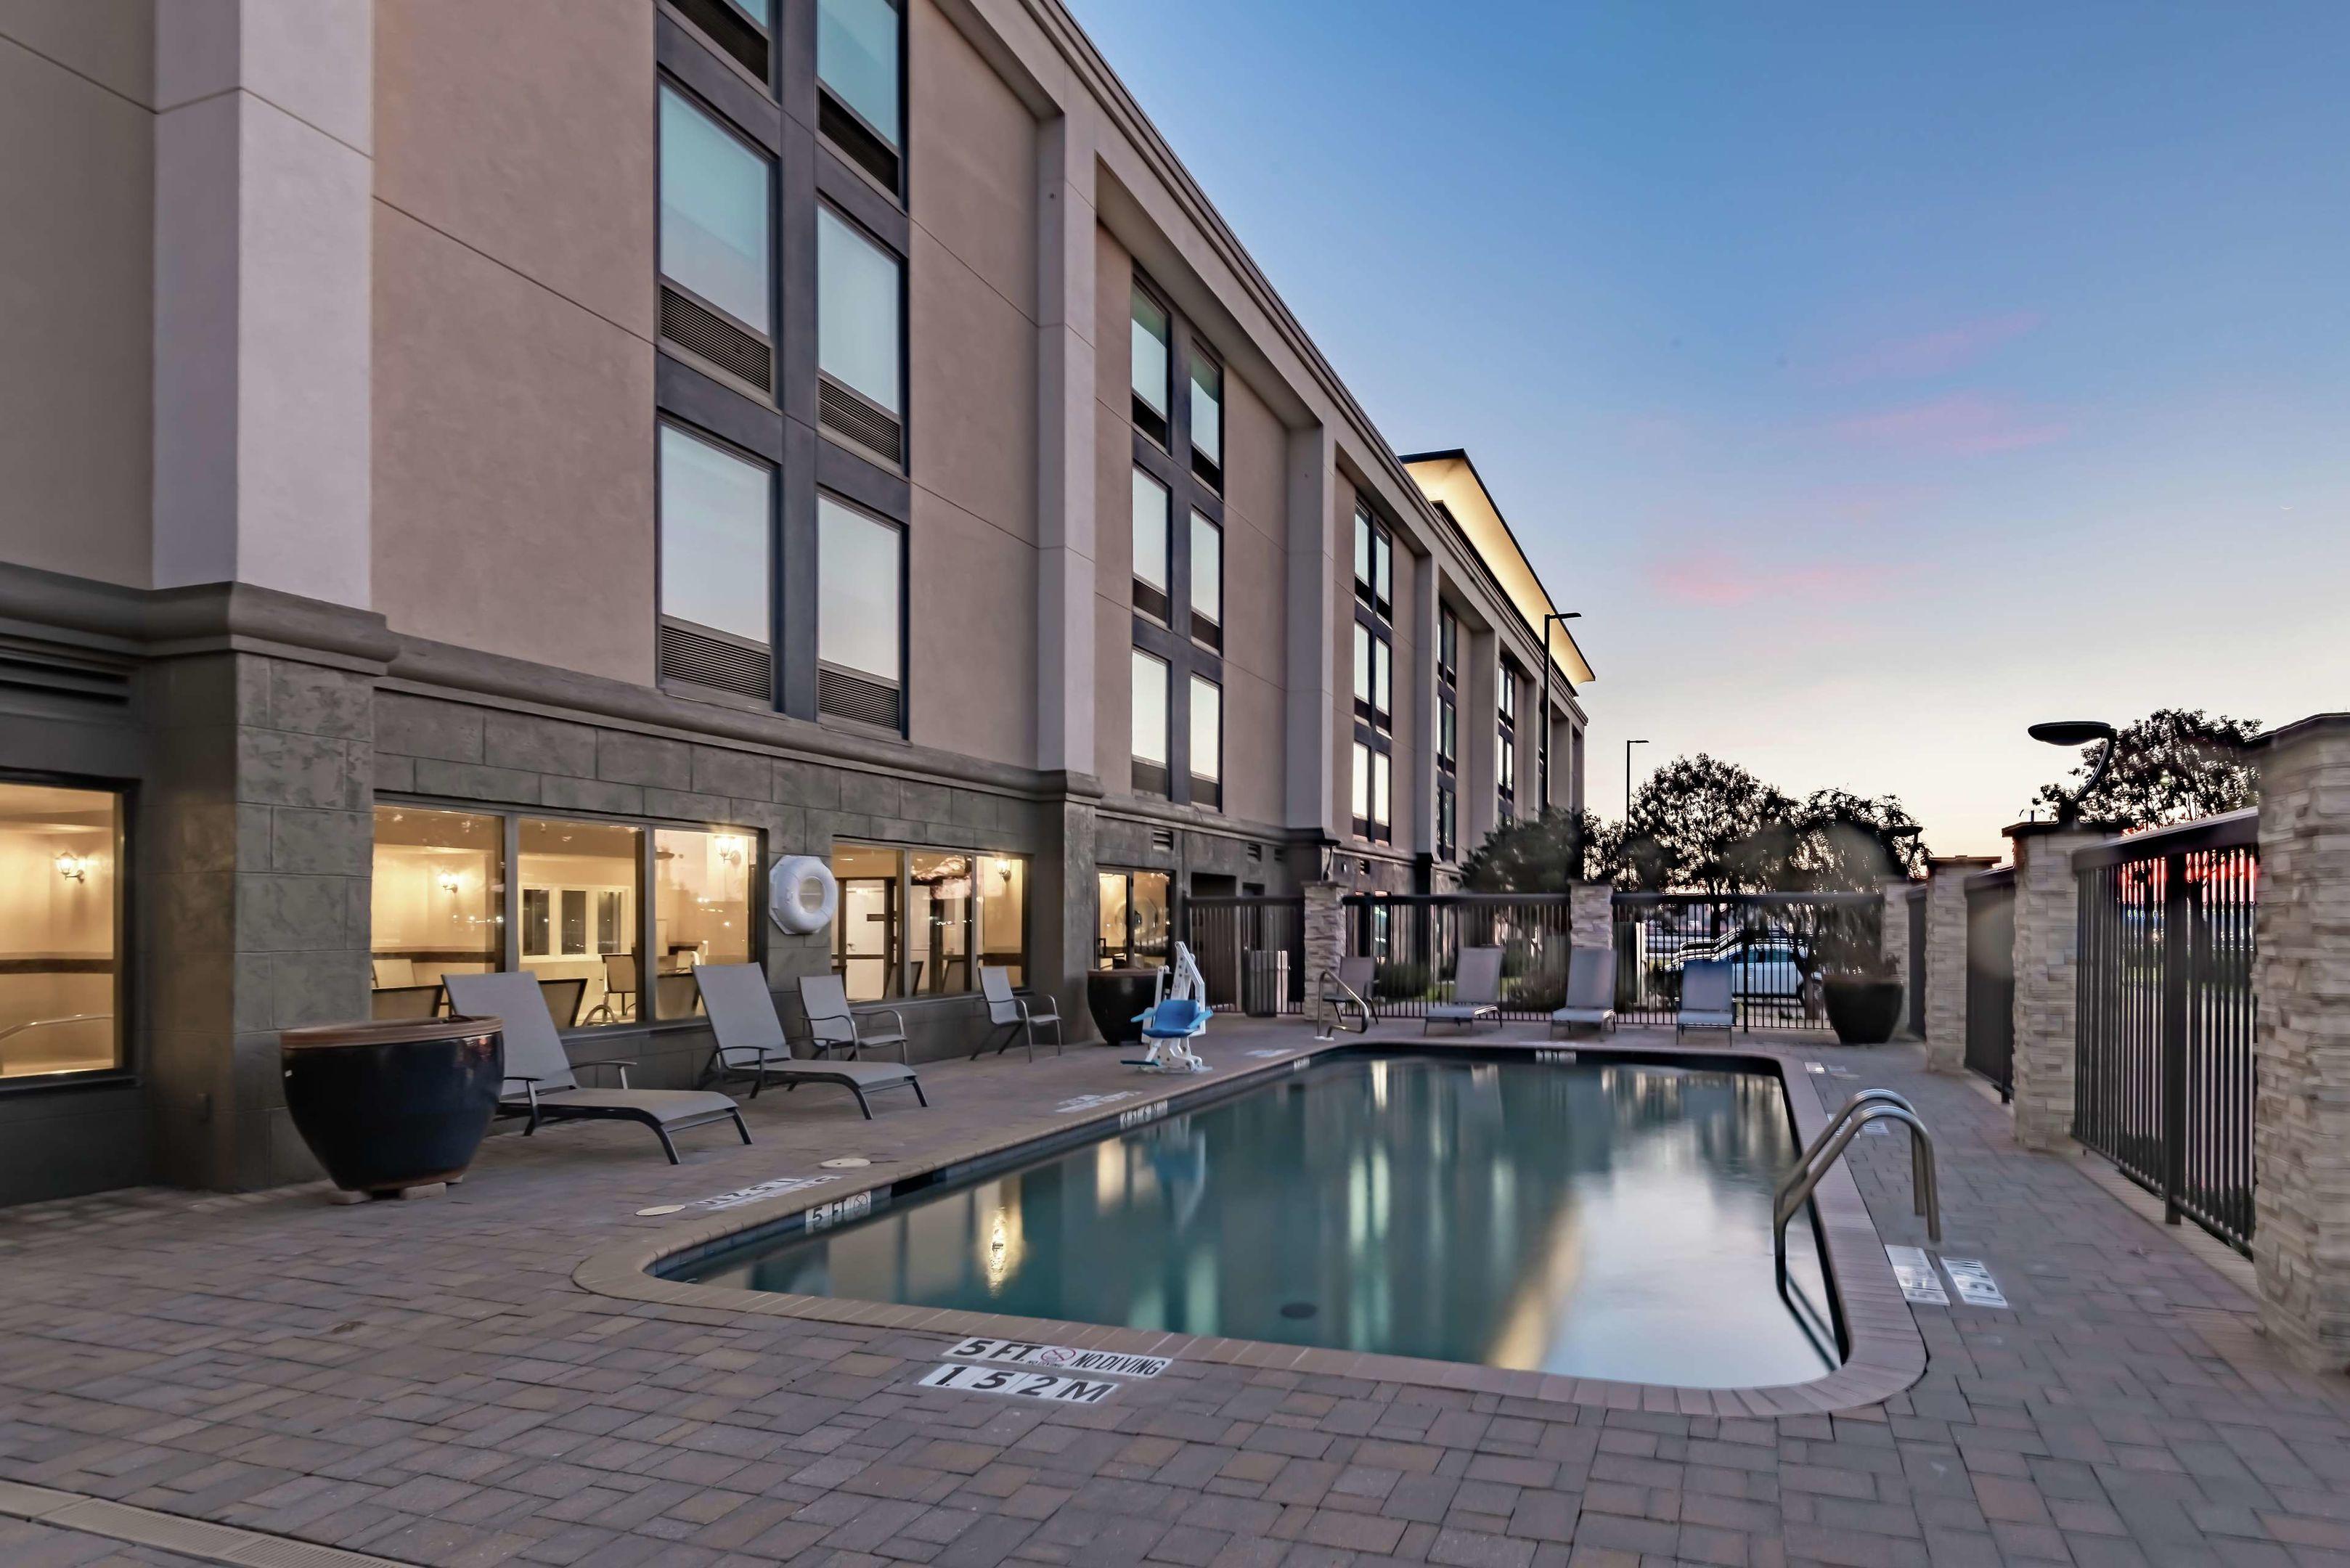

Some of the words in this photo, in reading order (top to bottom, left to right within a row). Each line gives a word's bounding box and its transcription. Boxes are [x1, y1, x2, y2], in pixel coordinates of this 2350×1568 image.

[812, 1206, 823, 1221] 5
[953, 1339, 996, 1356] 5
[1070, 1352, 1104, 1368] NO
[1095, 1355, 1166, 1376] DIVING
